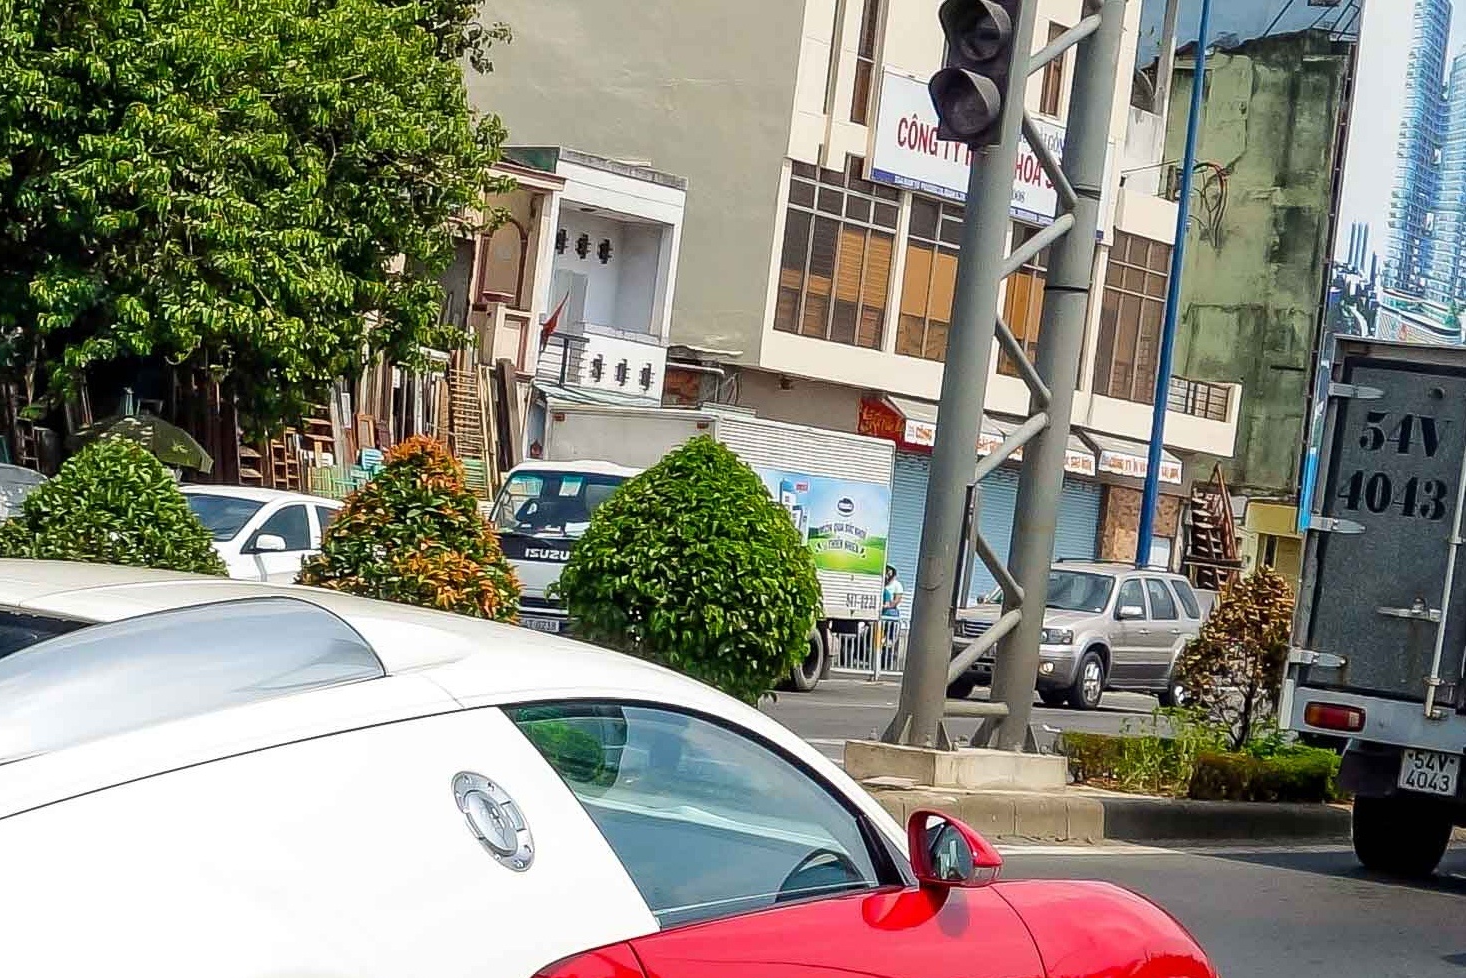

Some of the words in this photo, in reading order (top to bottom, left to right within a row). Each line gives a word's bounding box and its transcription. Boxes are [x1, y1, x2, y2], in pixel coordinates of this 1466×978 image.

[897, 113, 939, 157] CÔNG
[1359, 410, 1452, 458] 54V
[1338, 469, 1448, 521] 4043
[524, 547, 570, 561] ISUZU
[1414, 751, 1448, 772] 54V
[1405, 769, 1451, 792] 4043
